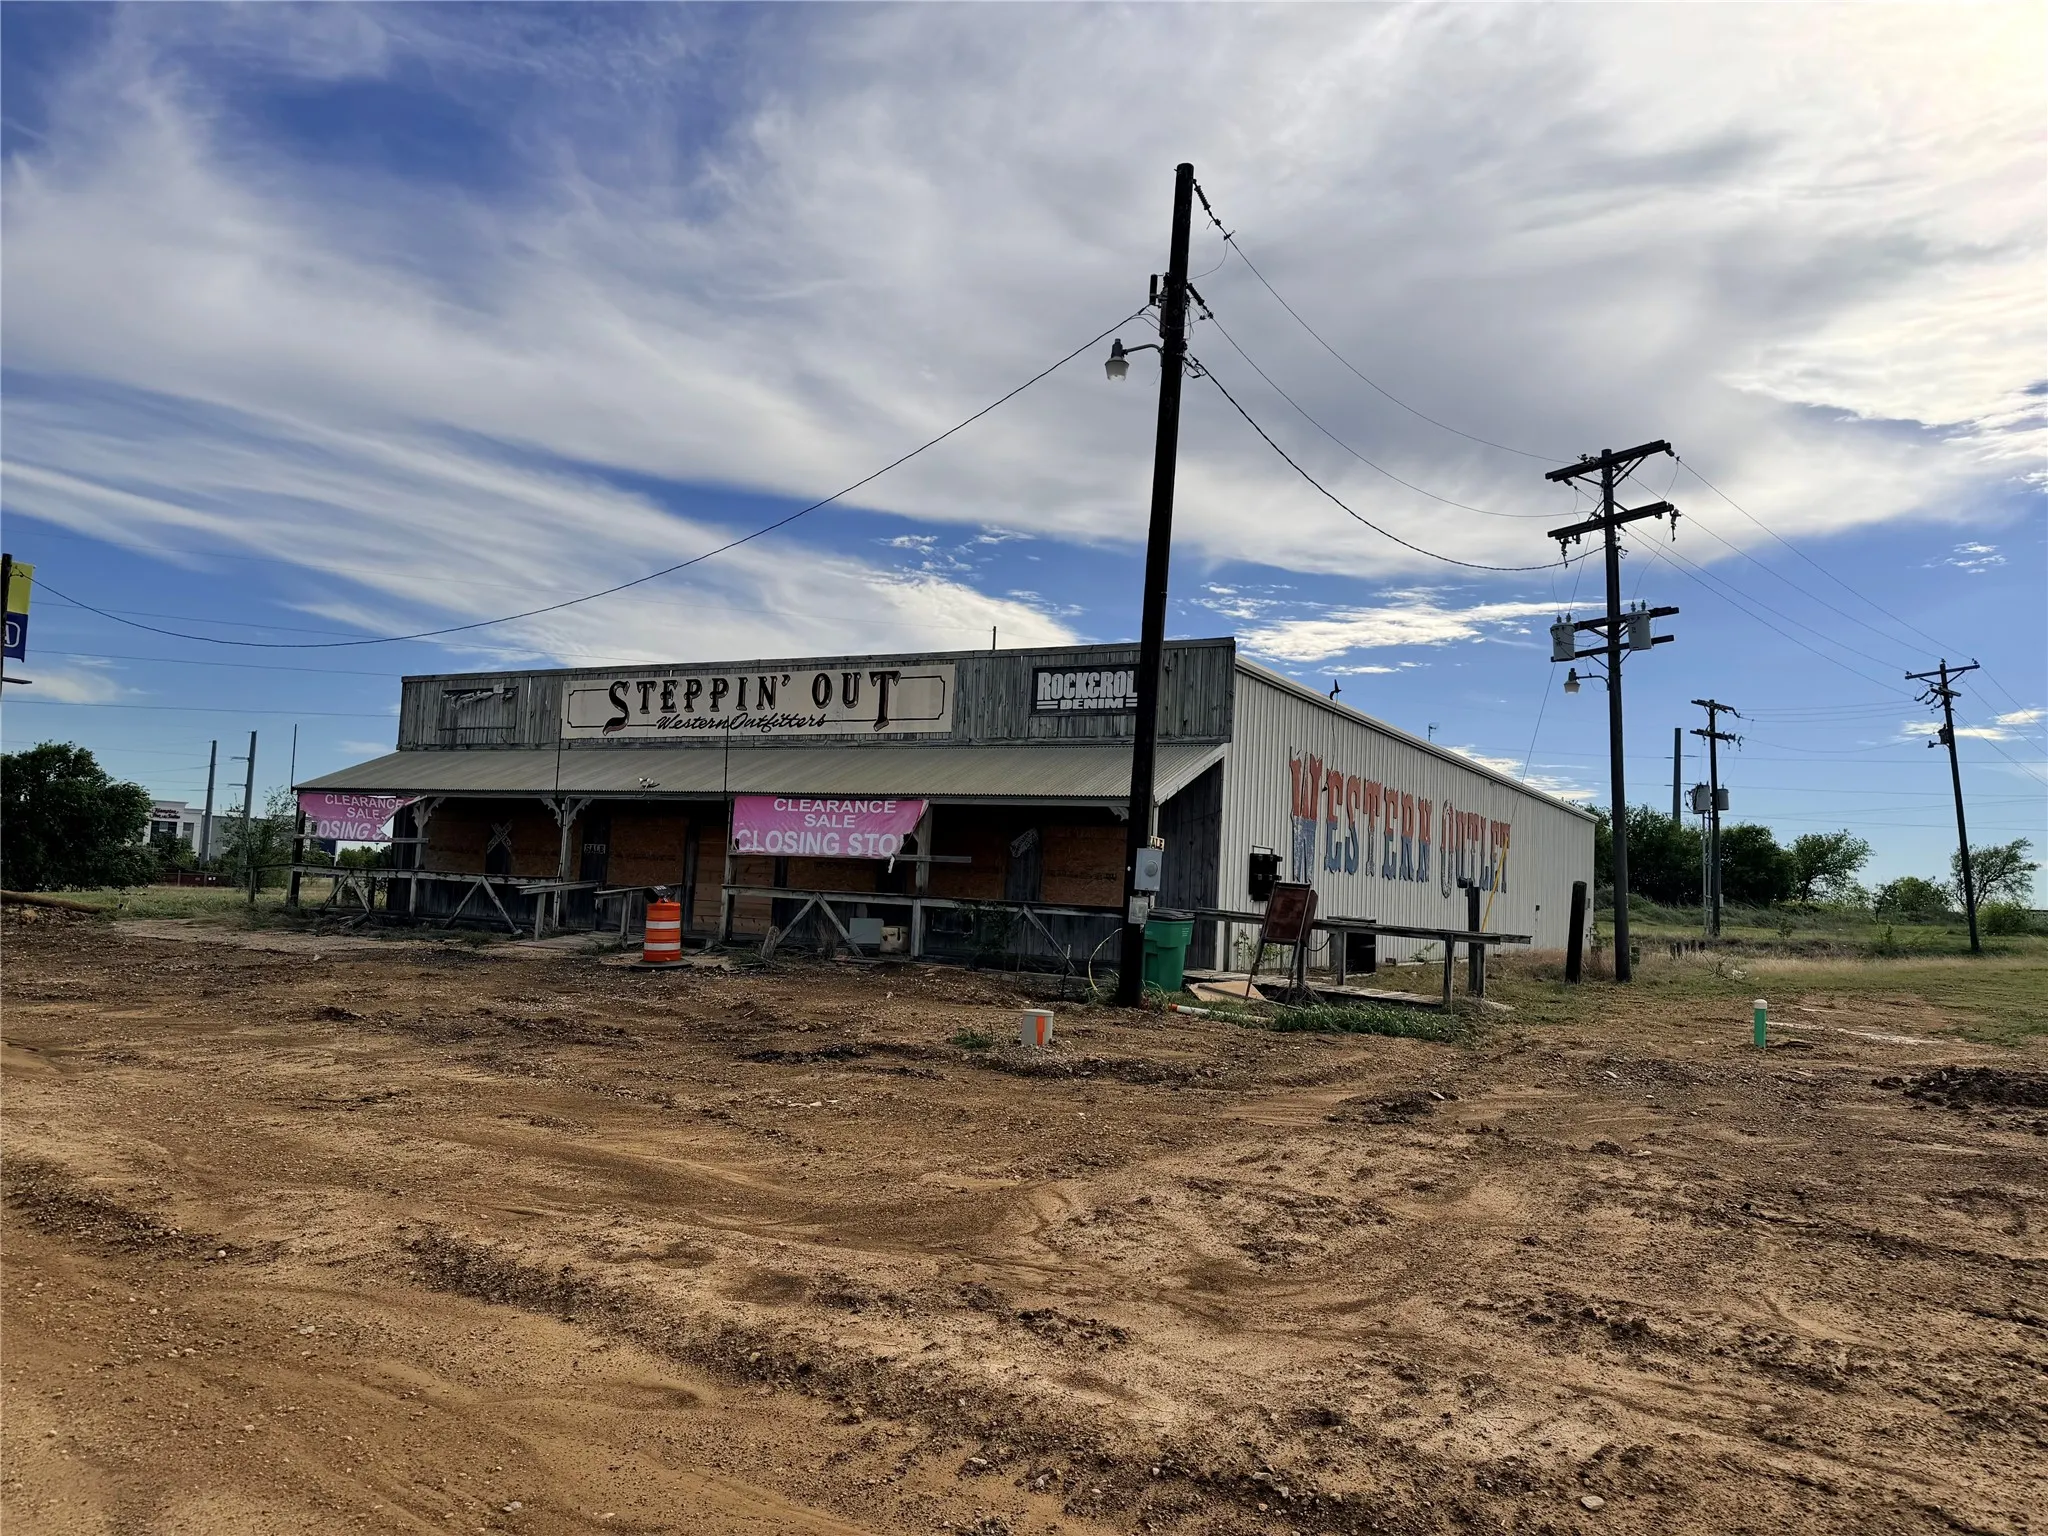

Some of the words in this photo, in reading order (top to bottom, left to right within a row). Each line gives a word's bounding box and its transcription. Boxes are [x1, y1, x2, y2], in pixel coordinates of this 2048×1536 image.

[602, 673, 791, 736] STEPPIN'
[811, 671, 902, 732] OUT
[1060, 698, 1124, 710] DENIM
[656, 713, 728, 730] Western
[729, 712, 827, 733] Outfitters
[325, 794, 403, 809] CLEARANCE
[774, 798, 897, 813] CLEARANCE
[346, 807, 380, 820] SALE
[804, 814, 856, 828] SALE
[1289, 746, 1432, 885] WESTERN
[1440, 800, 1511, 898] OUTLET
[317, 820, 371, 840] OSING
[736, 829, 840, 856] CLOSING
